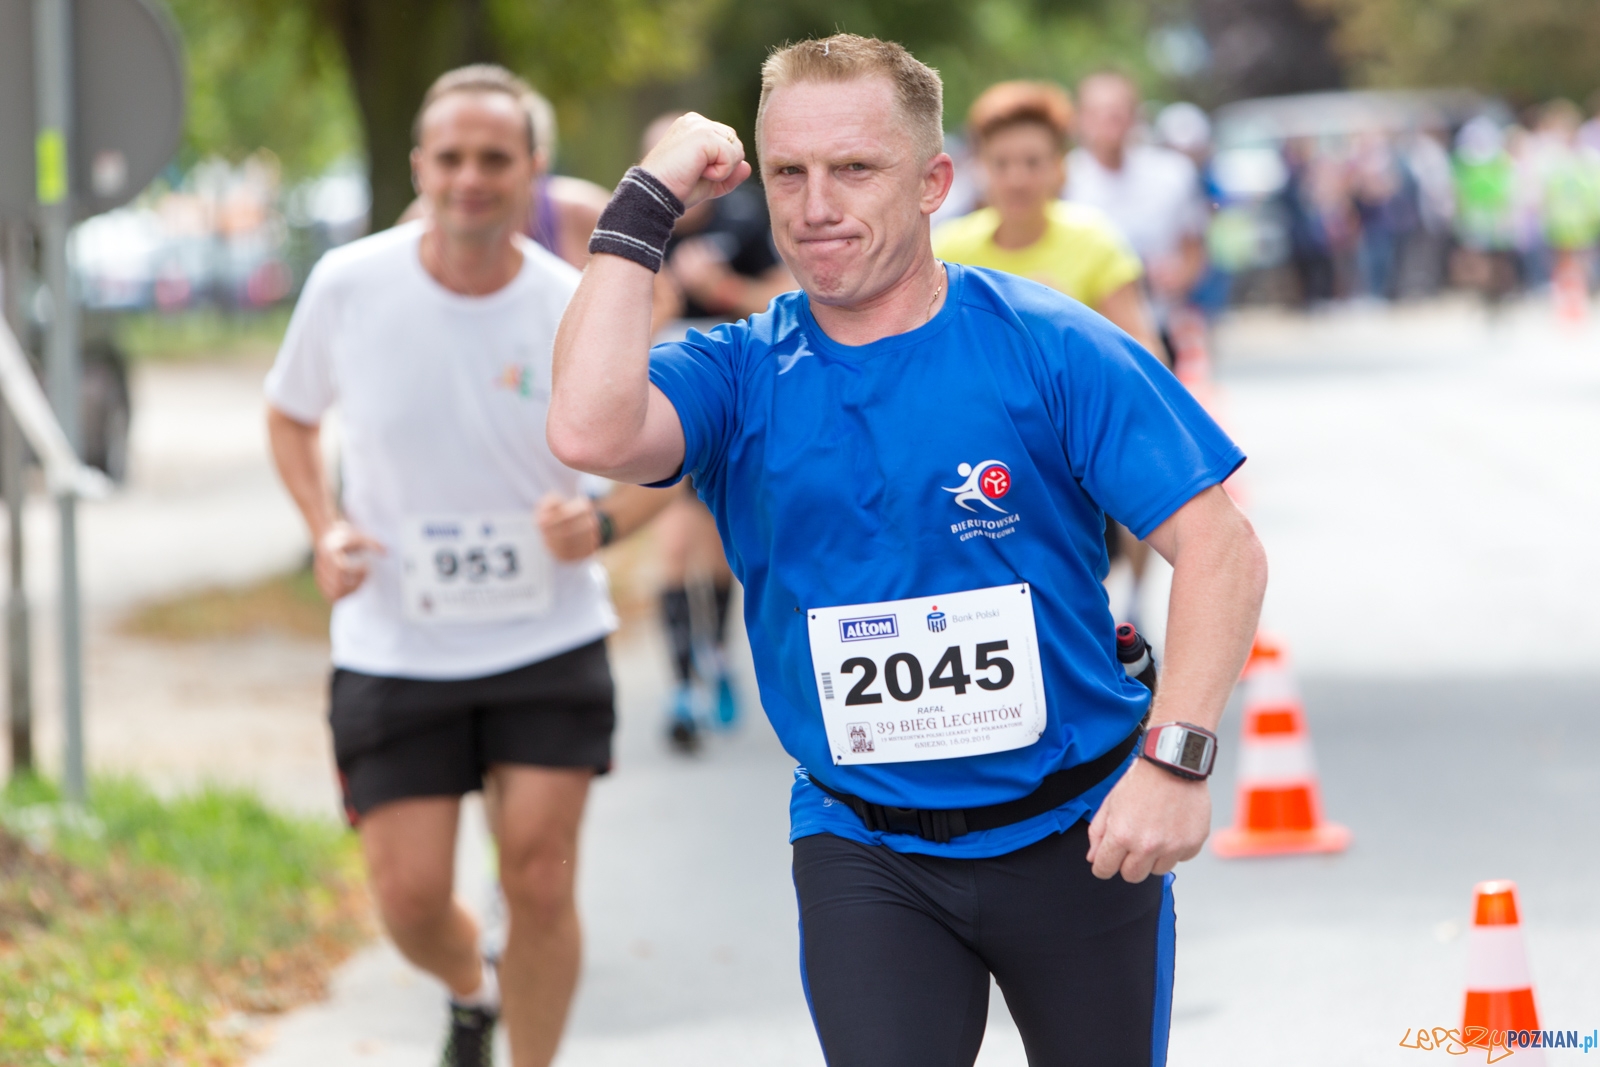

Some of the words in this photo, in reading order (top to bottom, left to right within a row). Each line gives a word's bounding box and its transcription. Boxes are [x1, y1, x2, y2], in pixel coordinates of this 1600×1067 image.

[950, 513, 1020, 534] BIERUTOWSKA
[959, 529, 983, 542] GRUPA
[434, 544, 519, 583] 953
[952, 613, 973, 623] Bank
[976, 608, 1000, 620] Polski
[840, 639, 1015, 707] 2045
[876, 721, 895, 735] 39
[900, 717, 937, 732] BIEG
[942, 703, 1023, 728] LECHITÓW
[917, 705, 945, 715] RAFAŁ
